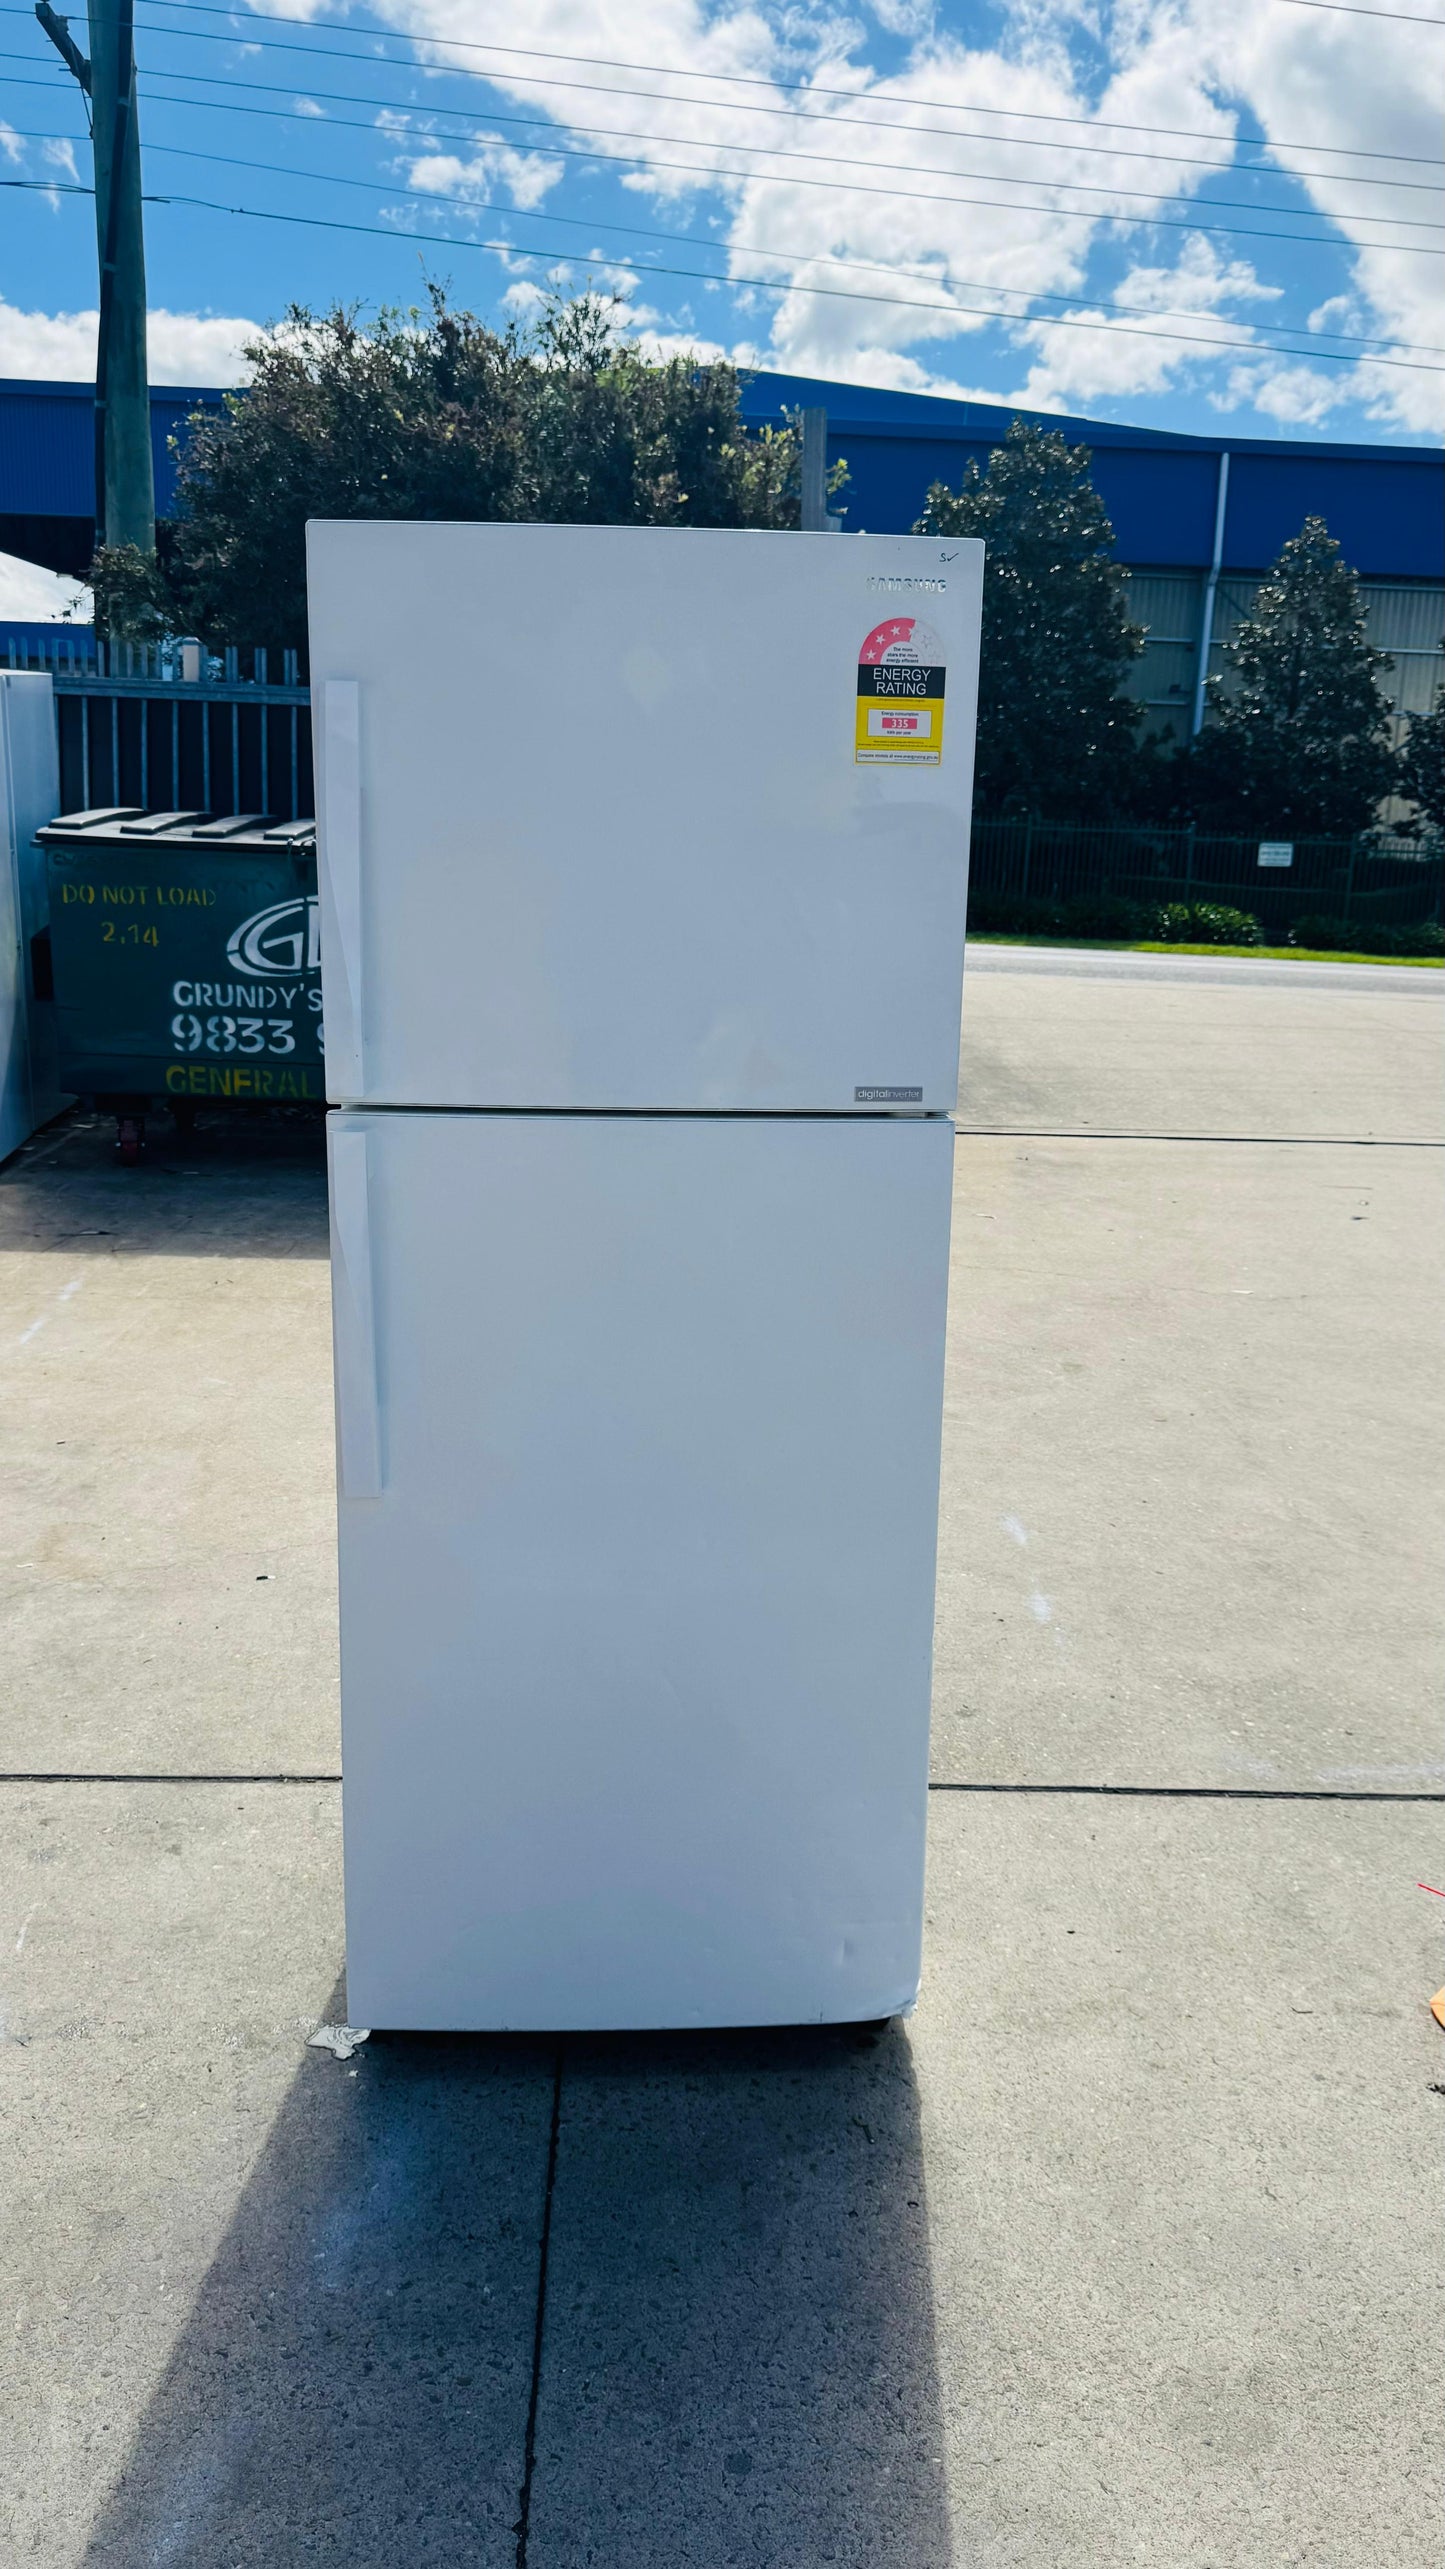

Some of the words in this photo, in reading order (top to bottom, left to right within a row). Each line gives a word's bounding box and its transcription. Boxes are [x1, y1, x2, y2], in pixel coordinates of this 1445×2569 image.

[865, 577, 946, 592] SAMSUNG
[873, 667, 931, 681] ENERGY
[876, 681, 927, 695] RATING
[891, 719, 909, 728] 335
[62, 884, 95, 904] DO
[102, 886, 148, 905] NOT
[156, 886, 216, 906] LOAD
[173, 981, 323, 1011] GRUNDY'S
[171, 1014, 296, 1053] 9833
[165, 1065, 318, 1099] GENERAL
